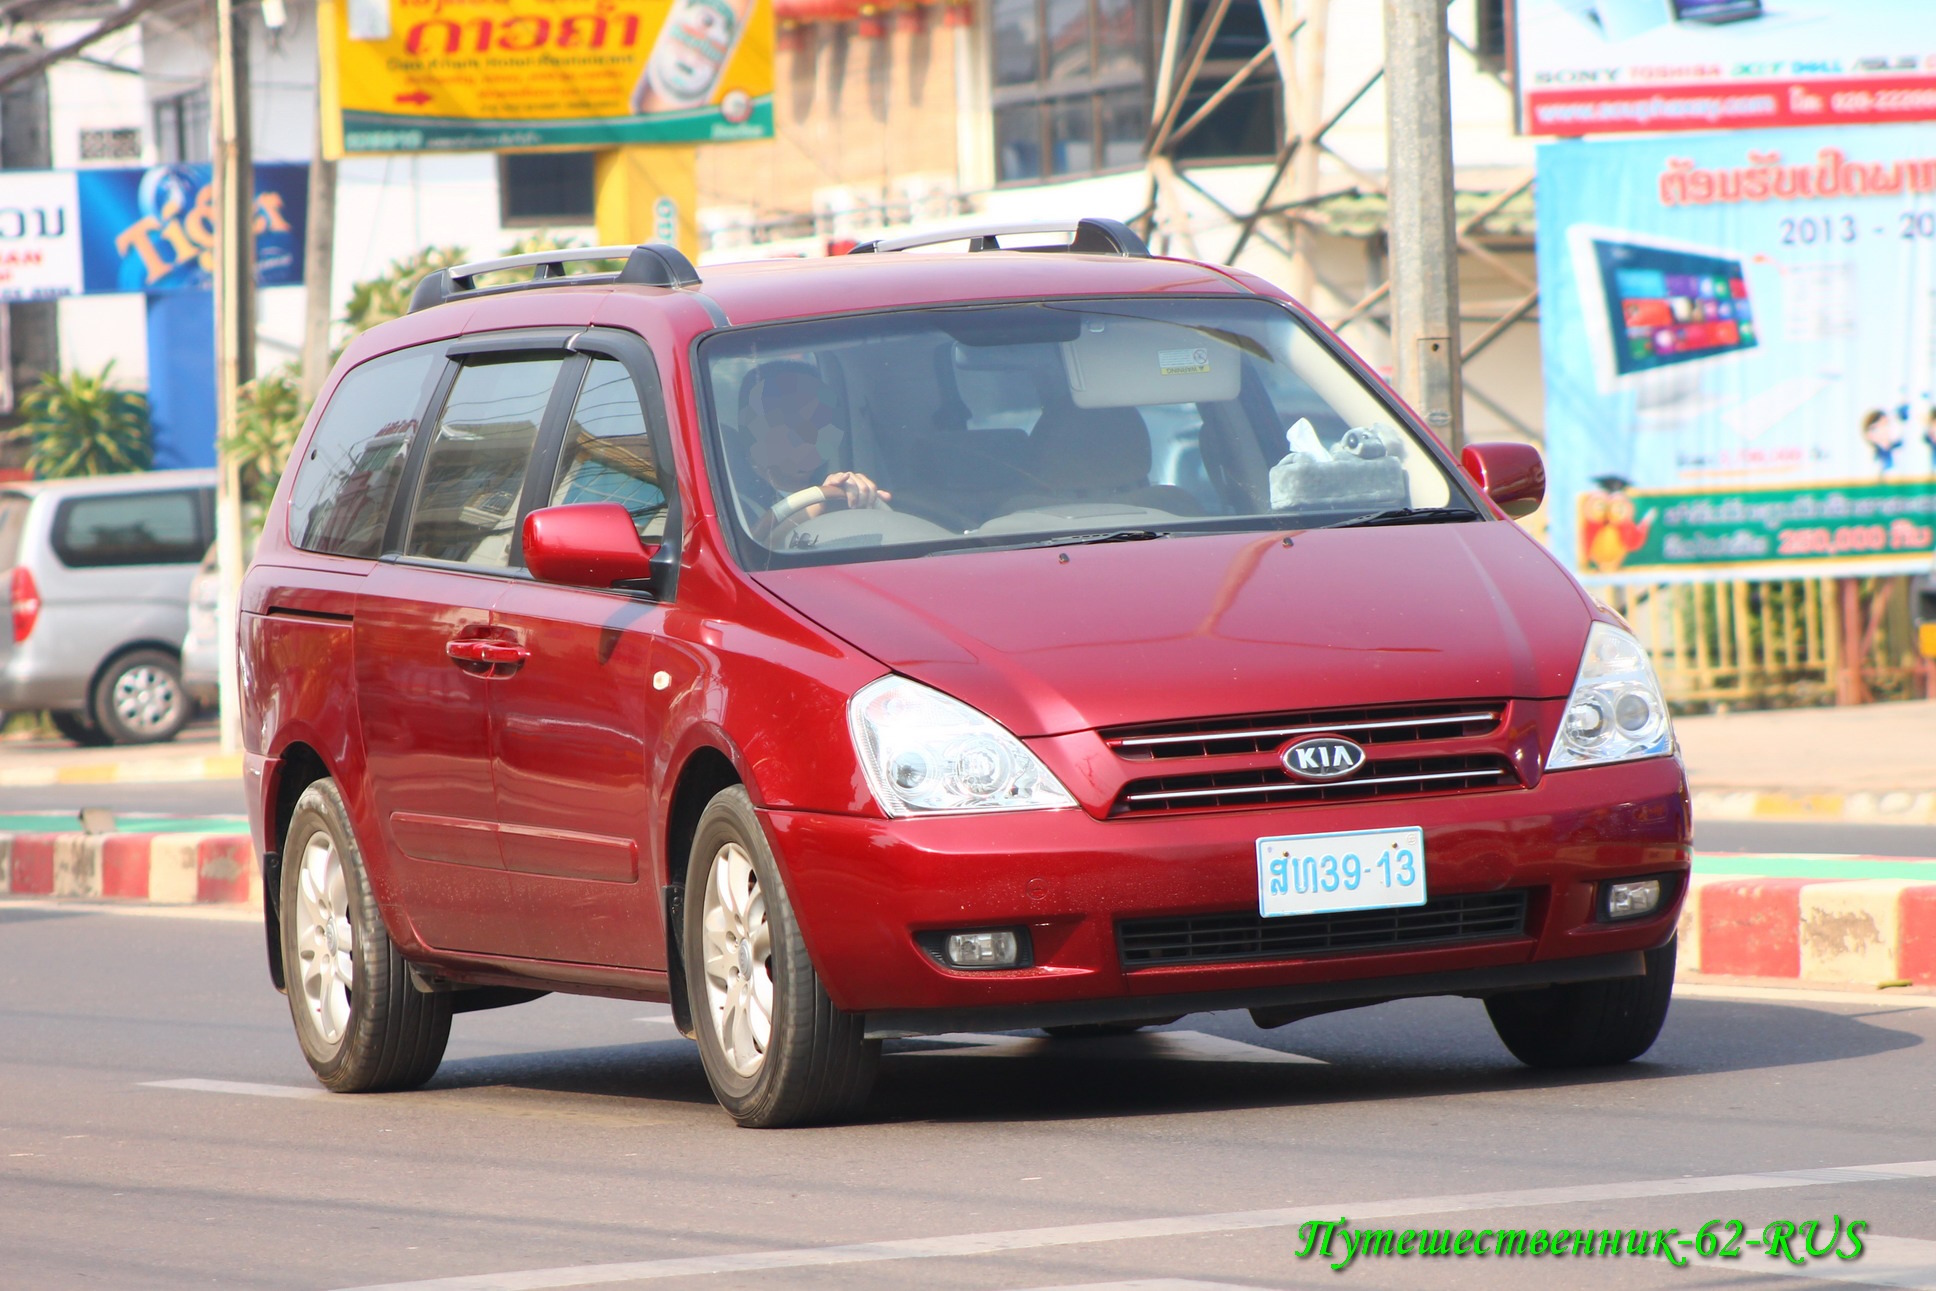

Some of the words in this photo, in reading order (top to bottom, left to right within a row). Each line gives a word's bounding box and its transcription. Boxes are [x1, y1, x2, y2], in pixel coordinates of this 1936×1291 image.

[1535, 67, 1620, 84] SONY
[1629, 64, 1721, 79] TOSHIBA
[115, 183, 291, 285] Tigr
[1780, 214, 1857, 246] 2013
[1296, 745, 1353, 769] KIA
